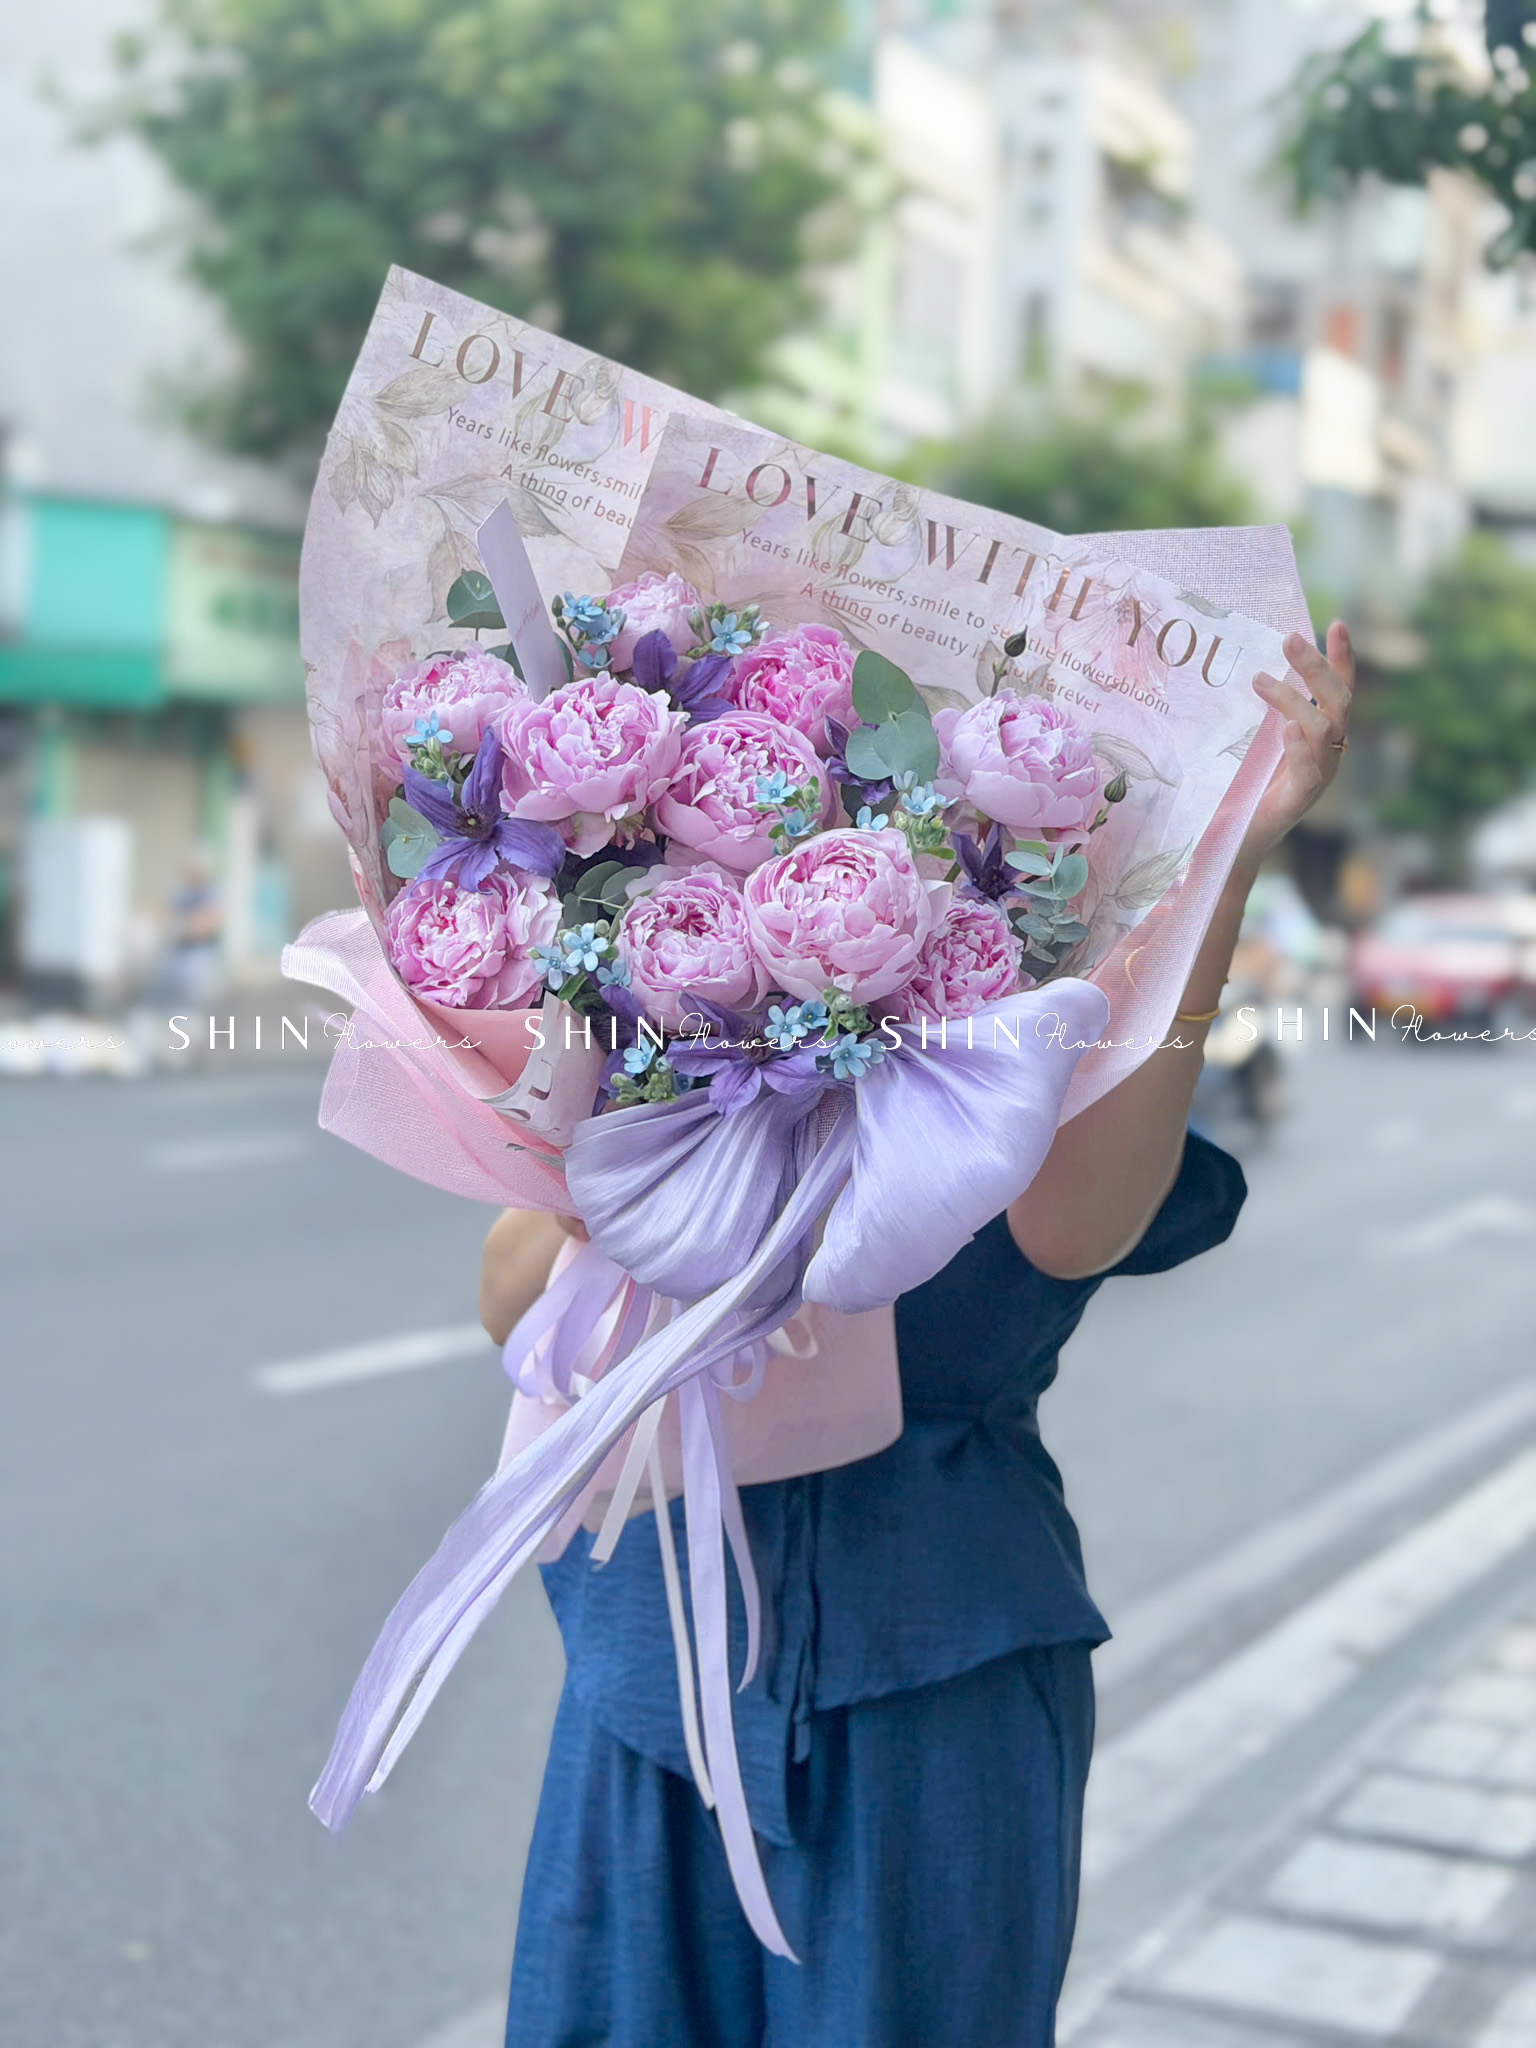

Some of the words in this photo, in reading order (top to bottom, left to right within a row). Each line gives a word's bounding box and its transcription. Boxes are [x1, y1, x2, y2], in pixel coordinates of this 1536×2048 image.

[409, 310, 586, 423] LOVE
[448, 405, 493, 440] Years
[498, 426, 531, 456] like
[499, 463, 514, 481] A
[519, 471, 568, 505] thing
[571, 495, 594, 511] of
[697, 446, 883, 543] LOVE
[926, 518, 1093, 622] WITH
[1125, 599, 1244, 688] YOU
[740, 527, 790, 559] Years
[796, 548, 831, 574] like
[966, 611, 985, 629] to
[990, 624, 1013, 640] se
[800, 582, 814, 598] A
[821, 588, 873, 622] thing
[876, 613, 900, 628] of
[900, 617, 969, 657] beauty
